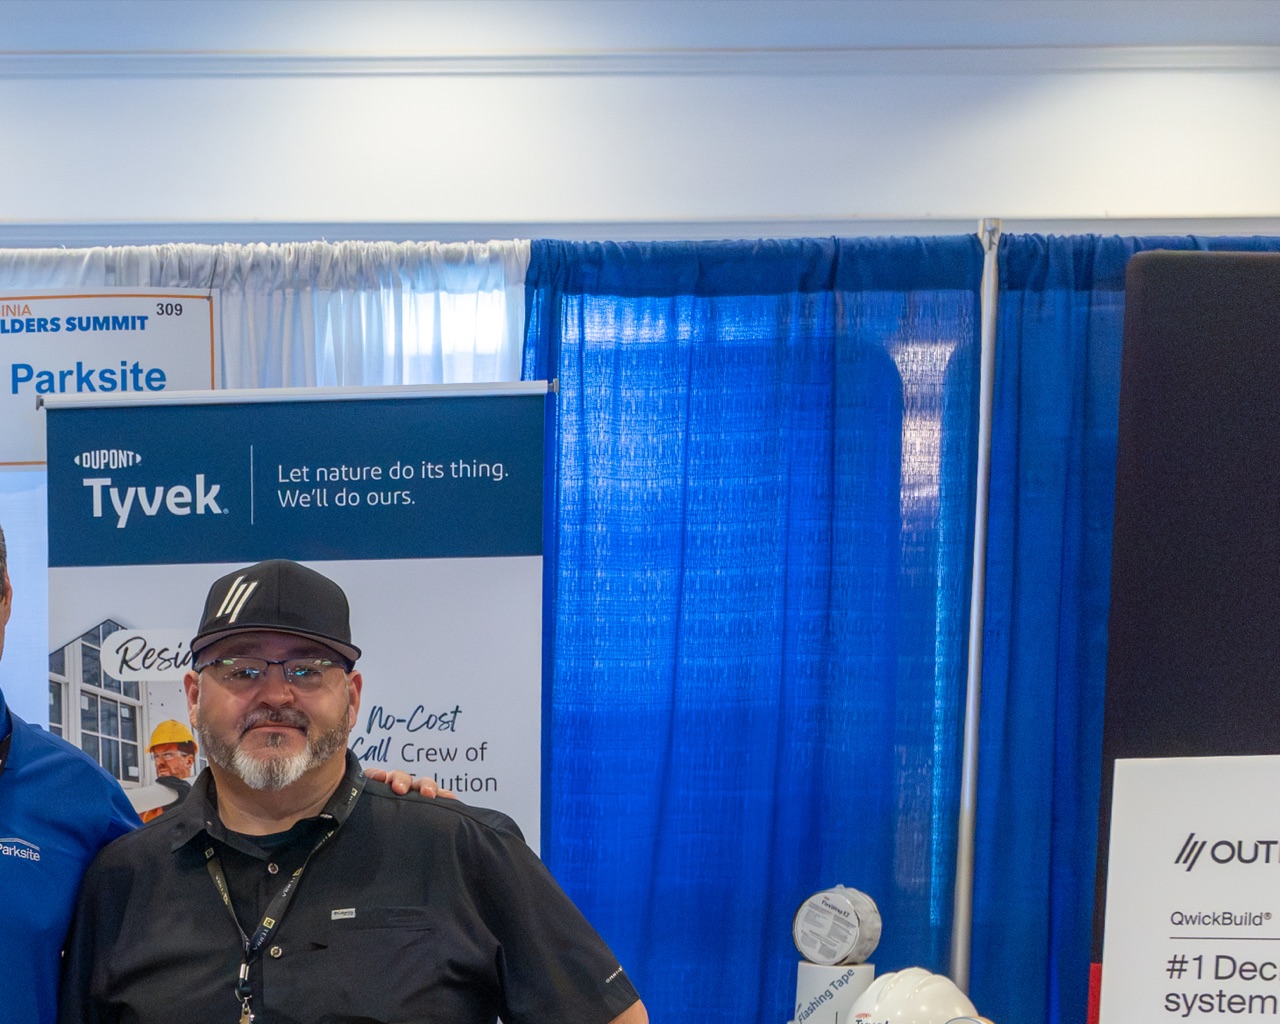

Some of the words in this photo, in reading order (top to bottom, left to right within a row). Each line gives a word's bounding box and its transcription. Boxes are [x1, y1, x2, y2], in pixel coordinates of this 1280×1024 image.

[156, 303, 183, 316] 309
[65, 315, 148, 332] SUMMIT
[11, 360, 167, 394] Parksite
[82, 450, 135, 469] DUPONT
[278, 464, 310, 483] Let
[316, 465, 383, 482] nature
[389, 461, 415, 480] do
[421, 461, 444, 480] its
[450, 459, 510, 482] thing.
[83, 474, 222, 528] Tyvek
[278, 489, 329, 508] We'll
[335, 488, 360, 507] do
[366, 491, 415, 507] ours.
[366, 705, 462, 734] No-Cost
[401, 743, 458, 762] Crew
[466, 741, 488, 762] of
[1211, 840, 1280, 864] OUT
[1166, 954, 1203, 980] #1
[1214, 955, 1280, 981] Dec
[798, 989, 834, 1024] Flashing
[829, 969, 855, 991] Tape
[1164, 989, 1278, 1017] system
